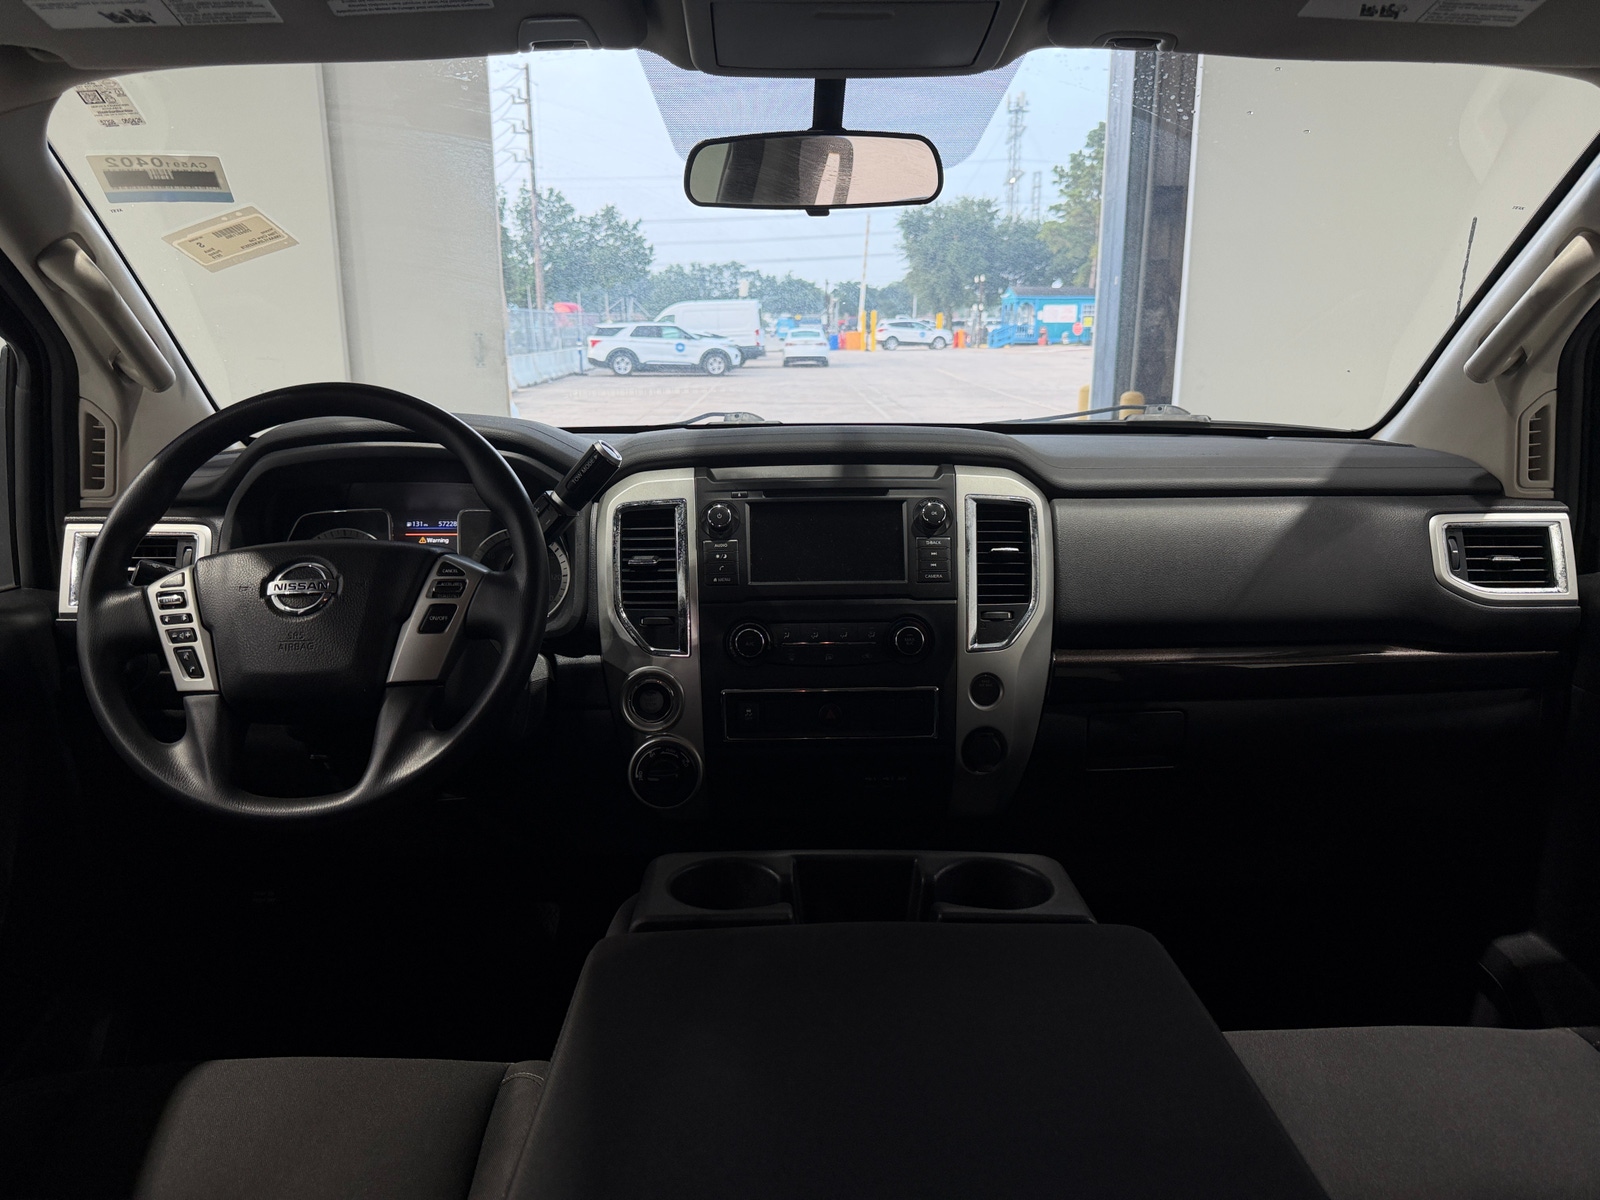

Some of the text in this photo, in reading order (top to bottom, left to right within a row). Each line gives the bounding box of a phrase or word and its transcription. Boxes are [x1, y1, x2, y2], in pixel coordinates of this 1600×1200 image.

[273, 581, 330, 592] NISSAN
[287, 631, 304, 640] SRS
[277, 641, 314, 652] AIRBAG
